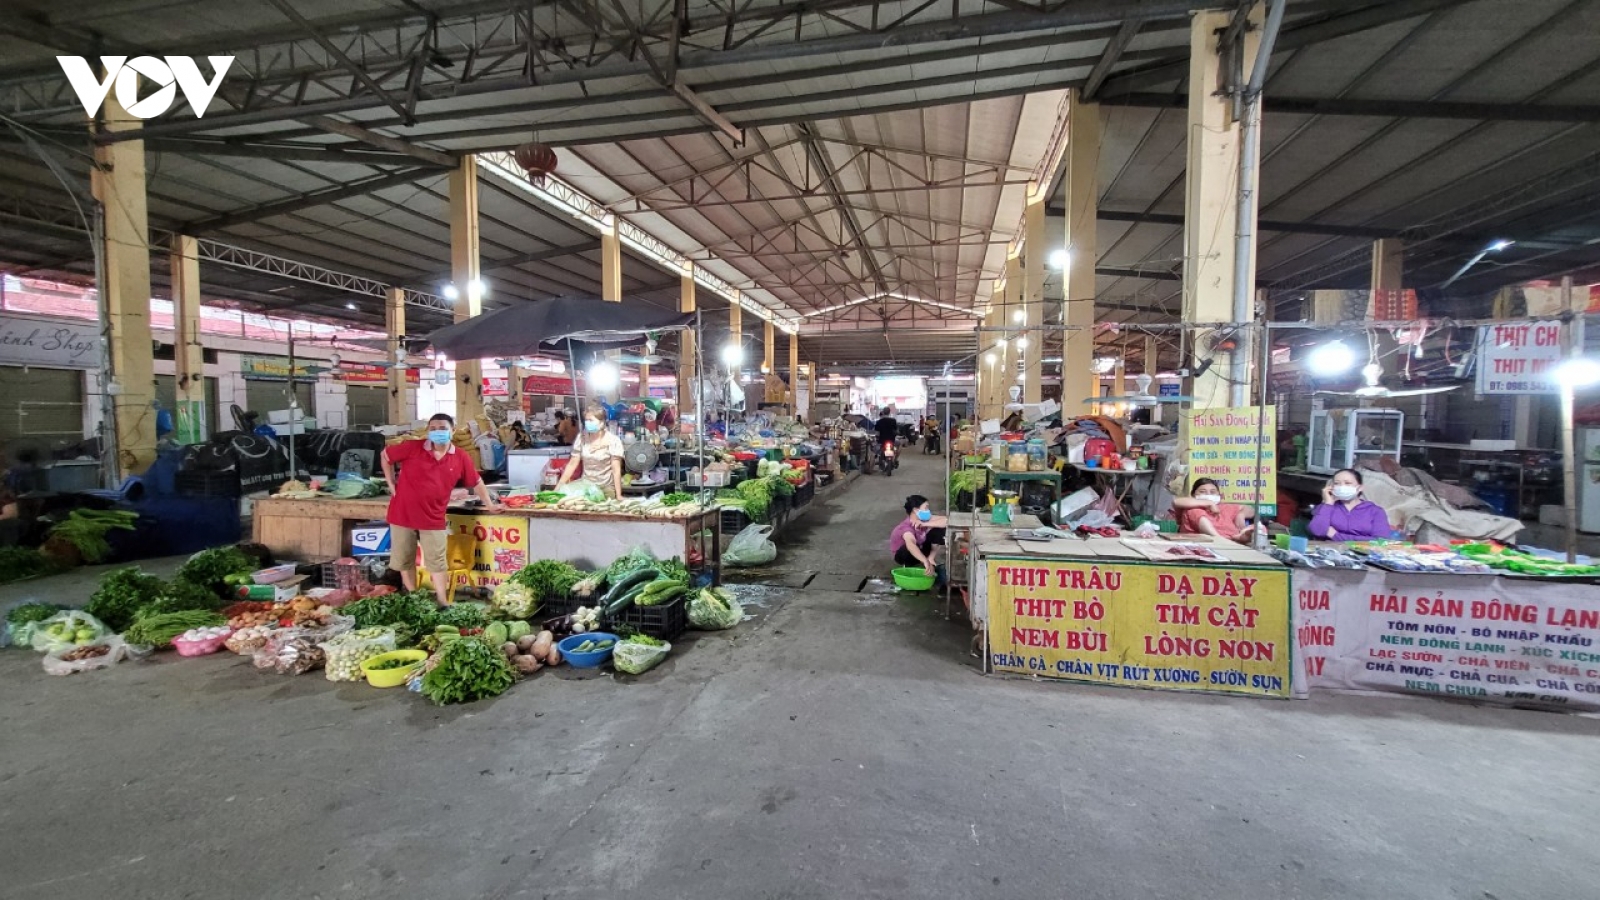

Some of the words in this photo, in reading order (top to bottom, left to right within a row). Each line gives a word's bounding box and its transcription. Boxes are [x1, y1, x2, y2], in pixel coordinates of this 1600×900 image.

[41, 328, 95, 358] Shop
[1494, 326, 1530, 351] THỊT
[1535, 326, 1560, 347] CH
[1494, 359, 1527, 377] THỊT
[355, 532, 377, 541] GS
[997, 567, 1050, 592] THỊT
[1056, 565, 1122, 591] TRÂU
[1158, 574, 1195, 599] DẠ
[1202, 571, 1258, 597] DÀY
[1013, 598, 1067, 622] THỊT
[1073, 596, 1105, 620] BÒ
[1299, 589, 1330, 610] CUA
[1370, 588, 1408, 614] HẢI
[1415, 590, 1464, 618] SẢN
[1470, 599, 1538, 624] ĐÔNG
[1546, 607, 1600, 631] LẠN
[1156, 604, 1200, 625] TIM
[1207, 602, 1259, 632] CẬT
[1387, 620, 1419, 632] TÔM
[1011, 627, 1060, 649] NEM
[1066, 627, 1108, 651] BÙI
[1144, 631, 1211, 658] LÒNG
[1218, 640, 1275, 662] NON
[1380, 635, 1414, 646] NEM
[992, 653, 1025, 668] CHÂN
[1029, 654, 1047, 671] GÀ
[1057, 658, 1093, 675] CHÂN
[1097, 664, 1119, 680] VỊT
[1123, 664, 1150, 681] RÚT
[1154, 667, 1200, 682] XƯƠNG
[1210, 669, 1247, 686] SƯỜN
[1252, 674, 1282, 693] SỤN
[1486, 674, 1520, 686] CUA
[1586, 669, 1600, 678] C
[1405, 680, 1439, 692] NEM
